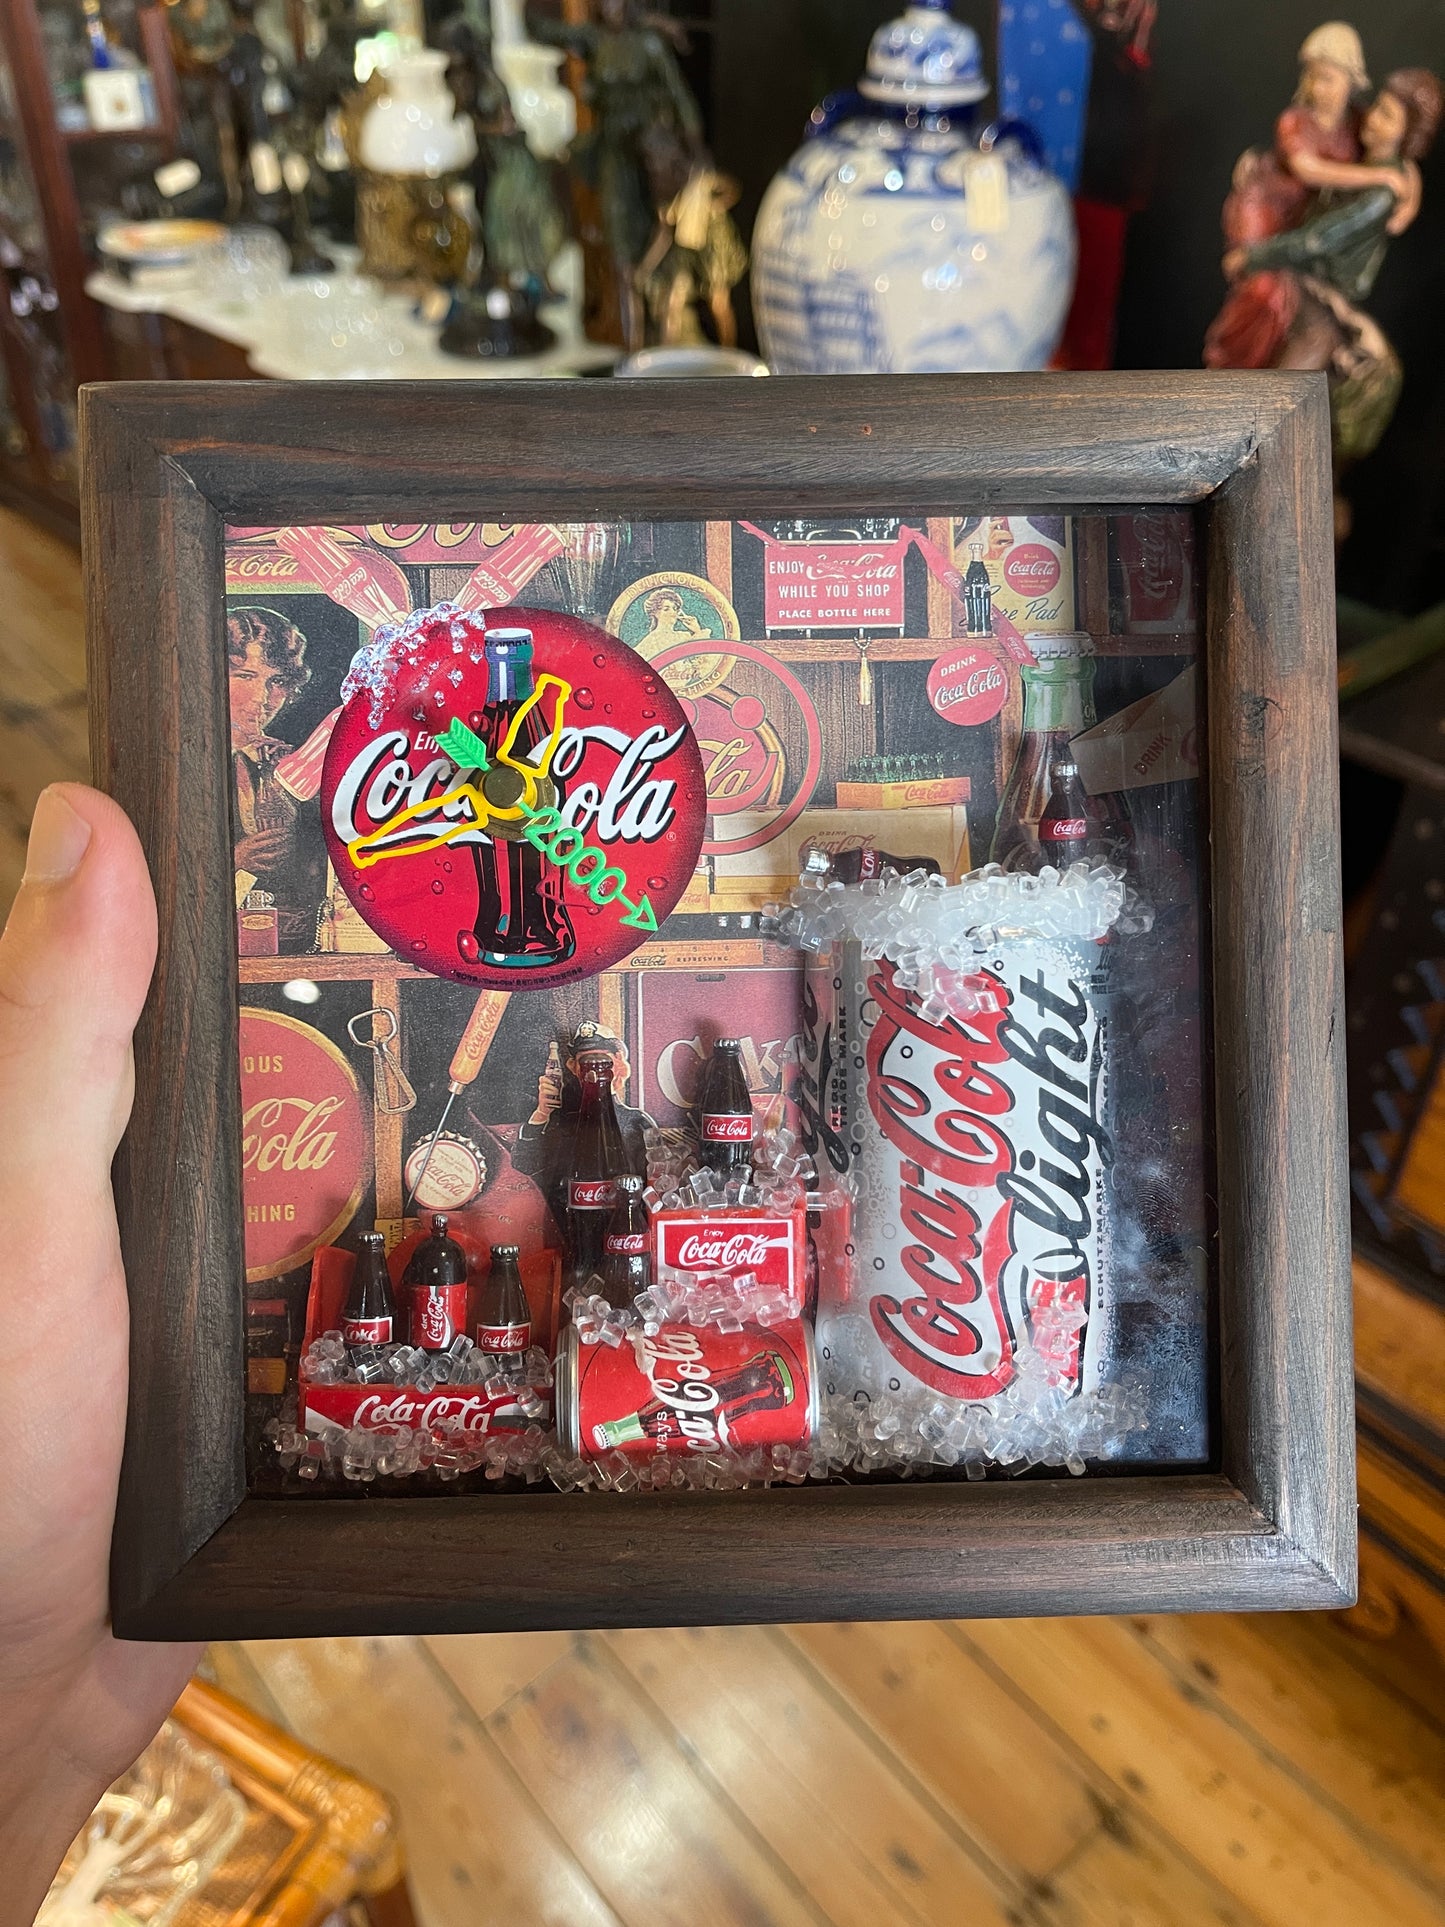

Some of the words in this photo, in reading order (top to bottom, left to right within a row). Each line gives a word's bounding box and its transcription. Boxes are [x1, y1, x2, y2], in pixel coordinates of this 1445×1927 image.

[769, 561, 804, 574] ENJOY
[1008, 560, 1056, 576] Coca-Cola
[626, 573, 708, 599] DELICIOUS
[779, 585, 817, 598] WHILE
[825, 584, 848, 598] YOU
[857, 584, 890, 597] SHOP
[779, 610, 812, 618] PLACE
[818, 609, 857, 617] BOTTLE
[863, 608, 890, 616] HERE
[1025, 597, 1064, 621] Pad
[941, 654, 977, 677] DRINK
[934, 664, 1002, 711] Coca-Cola
[332, 722, 687, 848] CocaCola
[523, 806, 627, 905] 2000
[840, 1006, 848, 1058] MARK
[996, 970, 1115, 1241] light
[706, 1119, 748, 1136] Coca-Cola
[607, 1234, 643, 1249] Coca-Cola
[704, 1229, 724, 1238] Enjoy
[678, 1234, 769, 1267] Coca-Cola
[427, 1295, 444, 1342] Coca-Cola
[346, 1325, 379, 1342] Coke
[481, 1331, 524, 1348] Coca-Cola
